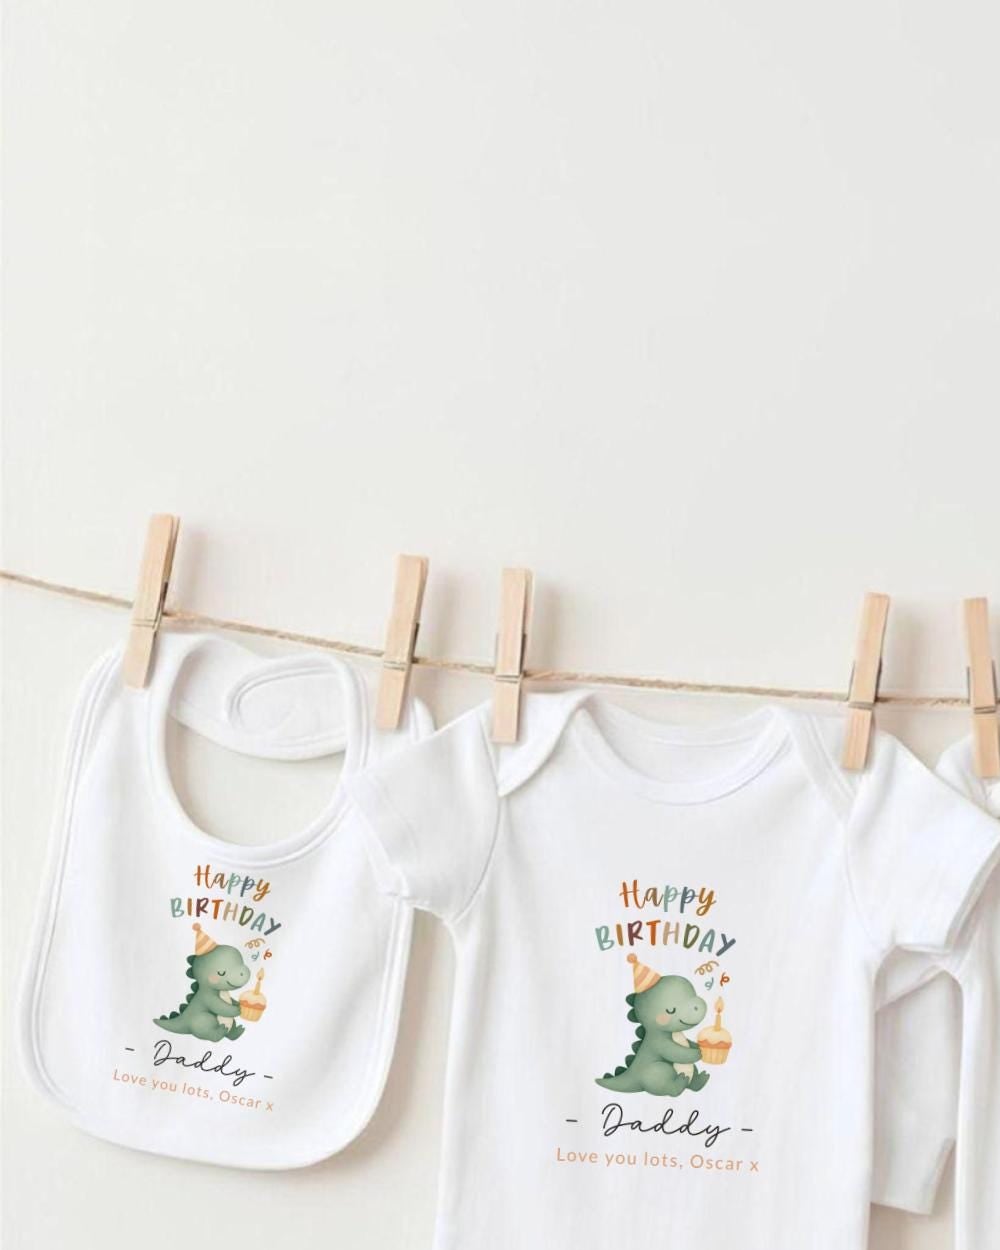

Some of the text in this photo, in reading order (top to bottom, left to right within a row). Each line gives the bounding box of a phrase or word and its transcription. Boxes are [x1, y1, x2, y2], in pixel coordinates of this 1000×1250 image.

[193, 863, 272, 903] Happy
[618, 878, 717, 917] Happy
[170, 897, 282, 937] BIRTHDAY
[594, 918, 737, 958] BIRTHDAY
[153, 1039, 256, 1088] Daddy
[113, 1069, 147, 1086] Love
[152, 1079, 177, 1092] you
[219, 1090, 262, 1109] Oscar
[601, 1102, 732, 1149] Daddy
[556, 1147, 598, 1164] Love
[605, 1154, 637, 1168] you
[689, 1154, 743, 1172] Oscar
